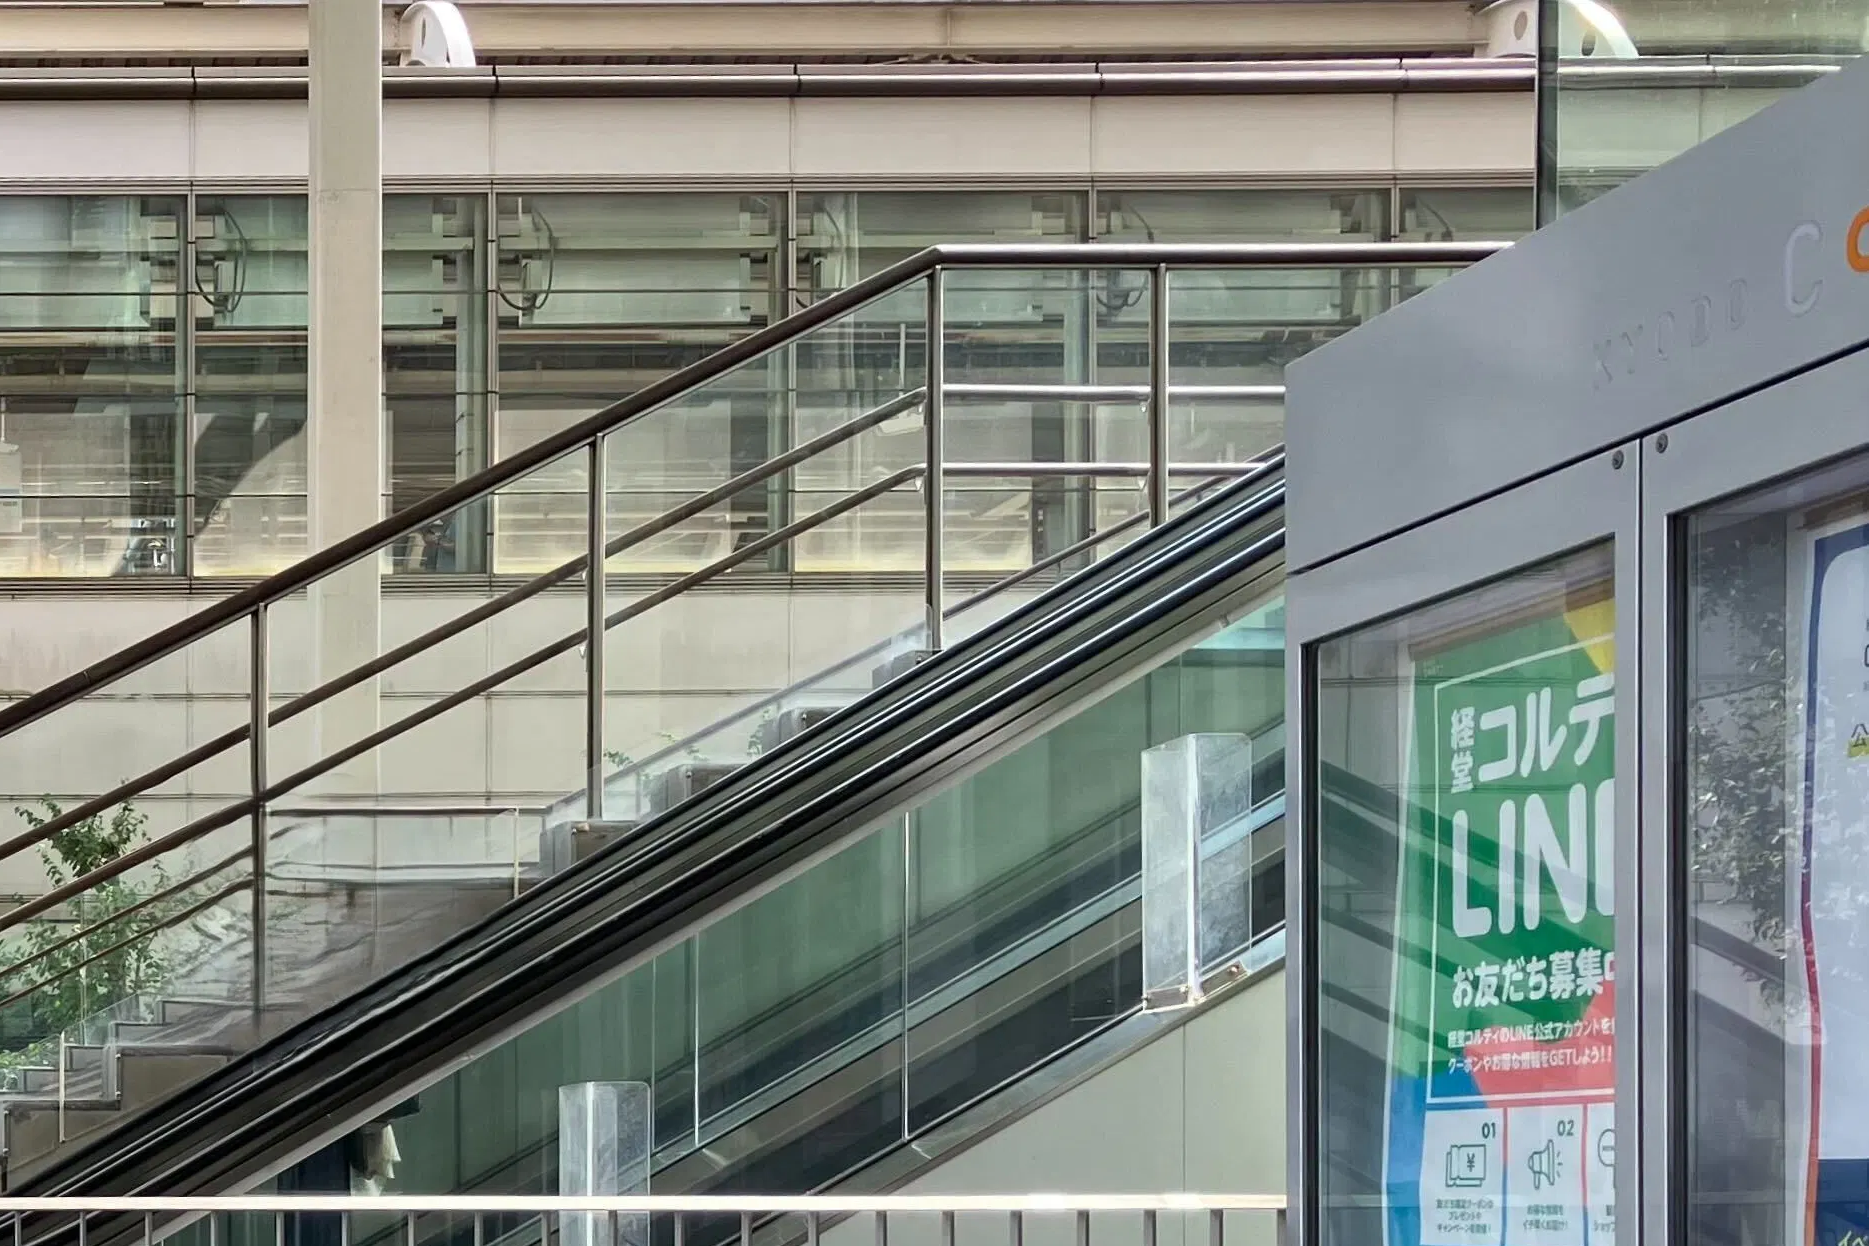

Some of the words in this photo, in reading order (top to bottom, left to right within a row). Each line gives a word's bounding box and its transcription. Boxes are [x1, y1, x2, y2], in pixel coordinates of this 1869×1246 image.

[1451, 706, 1476, 794] 経堂
[1481, 1122, 1497, 1139] 01
[1557, 1119, 1575, 1138] 02
